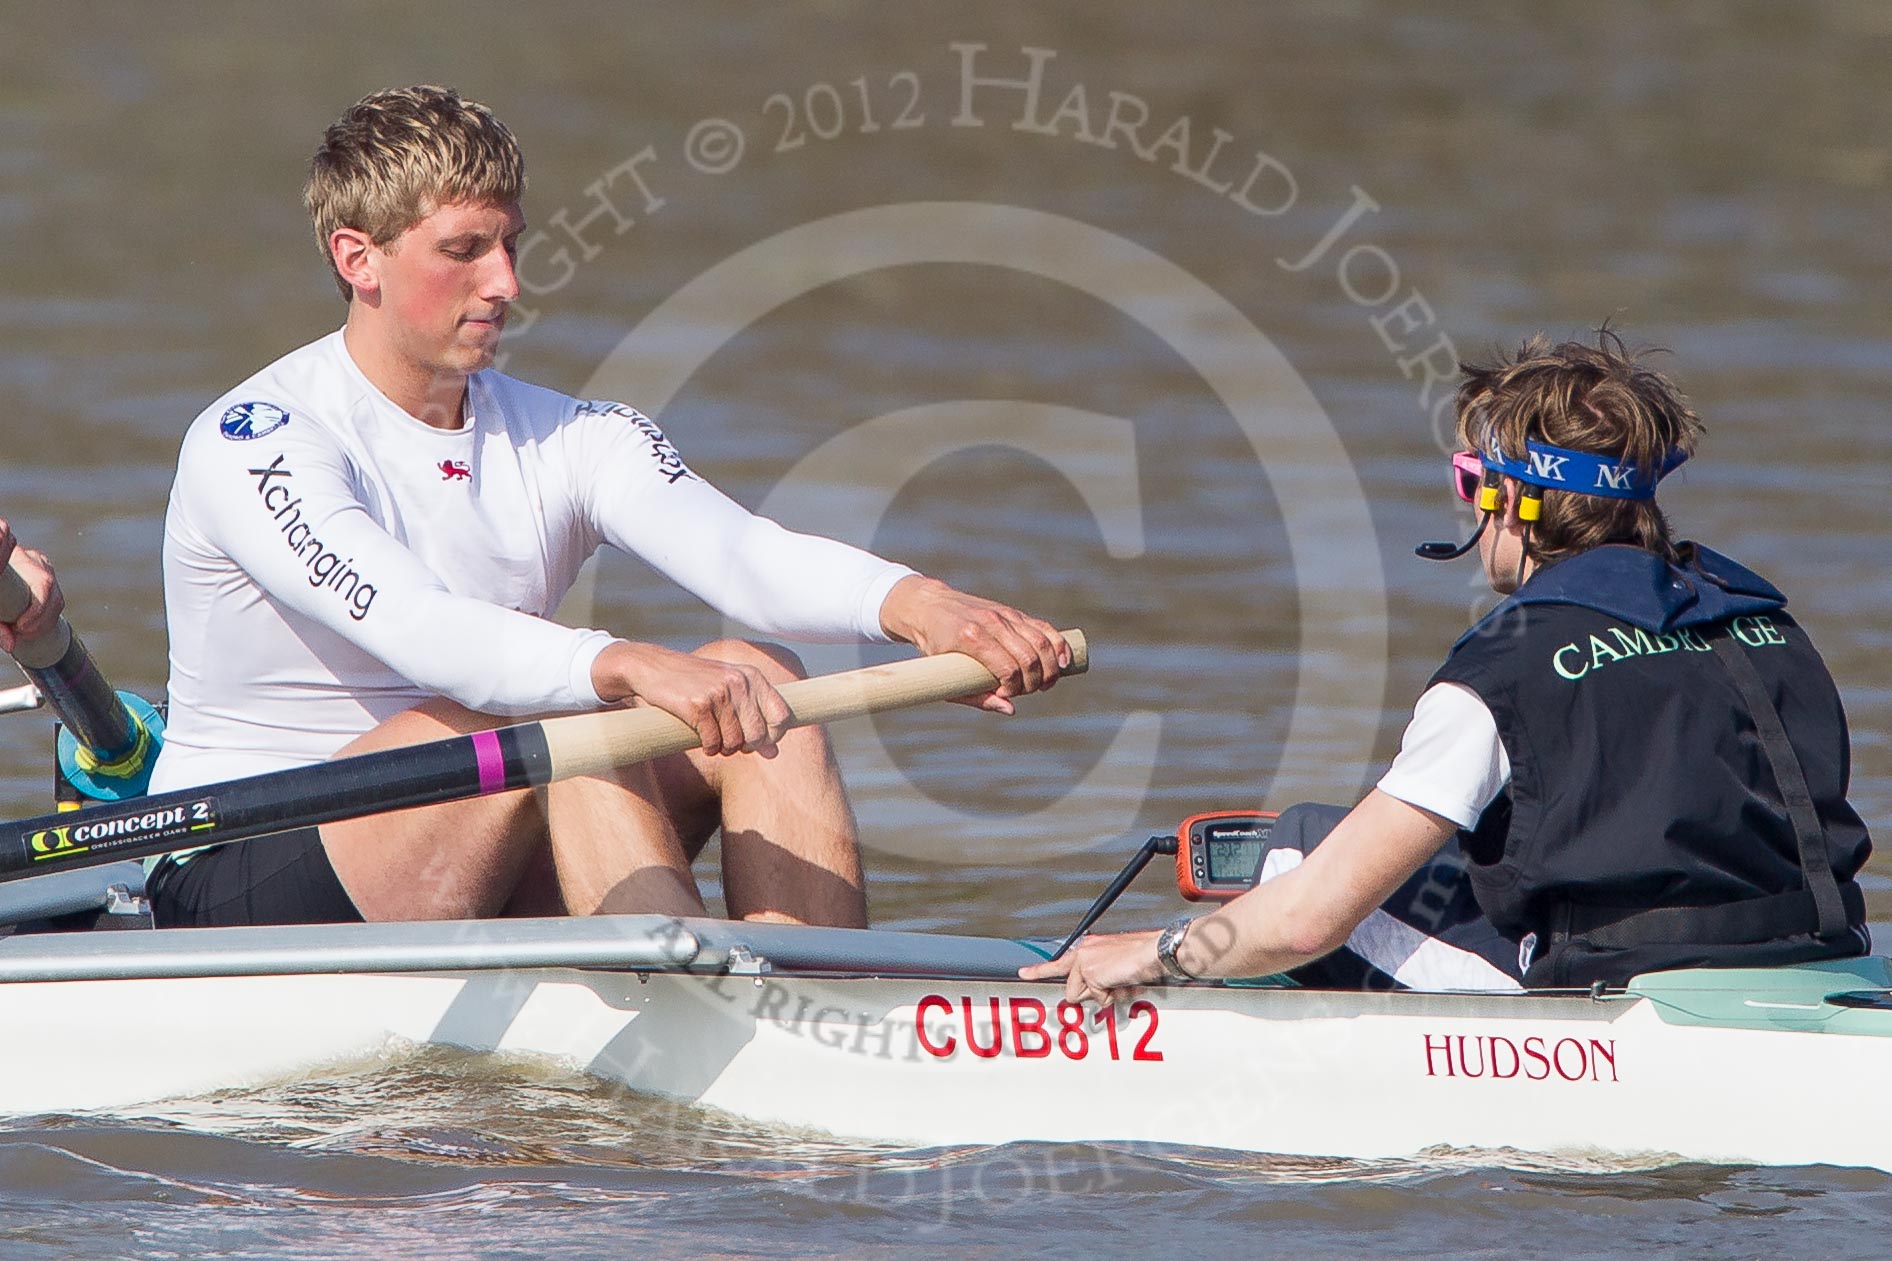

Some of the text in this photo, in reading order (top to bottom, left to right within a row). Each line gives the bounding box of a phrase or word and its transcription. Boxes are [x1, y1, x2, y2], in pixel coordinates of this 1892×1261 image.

[1524, 450, 1570, 482] NK
[1594, 464, 1636, 490] NK
[247, 453, 378, 622] Xchanging
[1553, 616, 1786, 680] CAMBRIGE
[74, 805, 186, 842] concept
[192, 802, 209, 820] 2
[915, 994, 1165, 1063] CUB812
[1423, 1033, 1620, 1083] HUDSON
